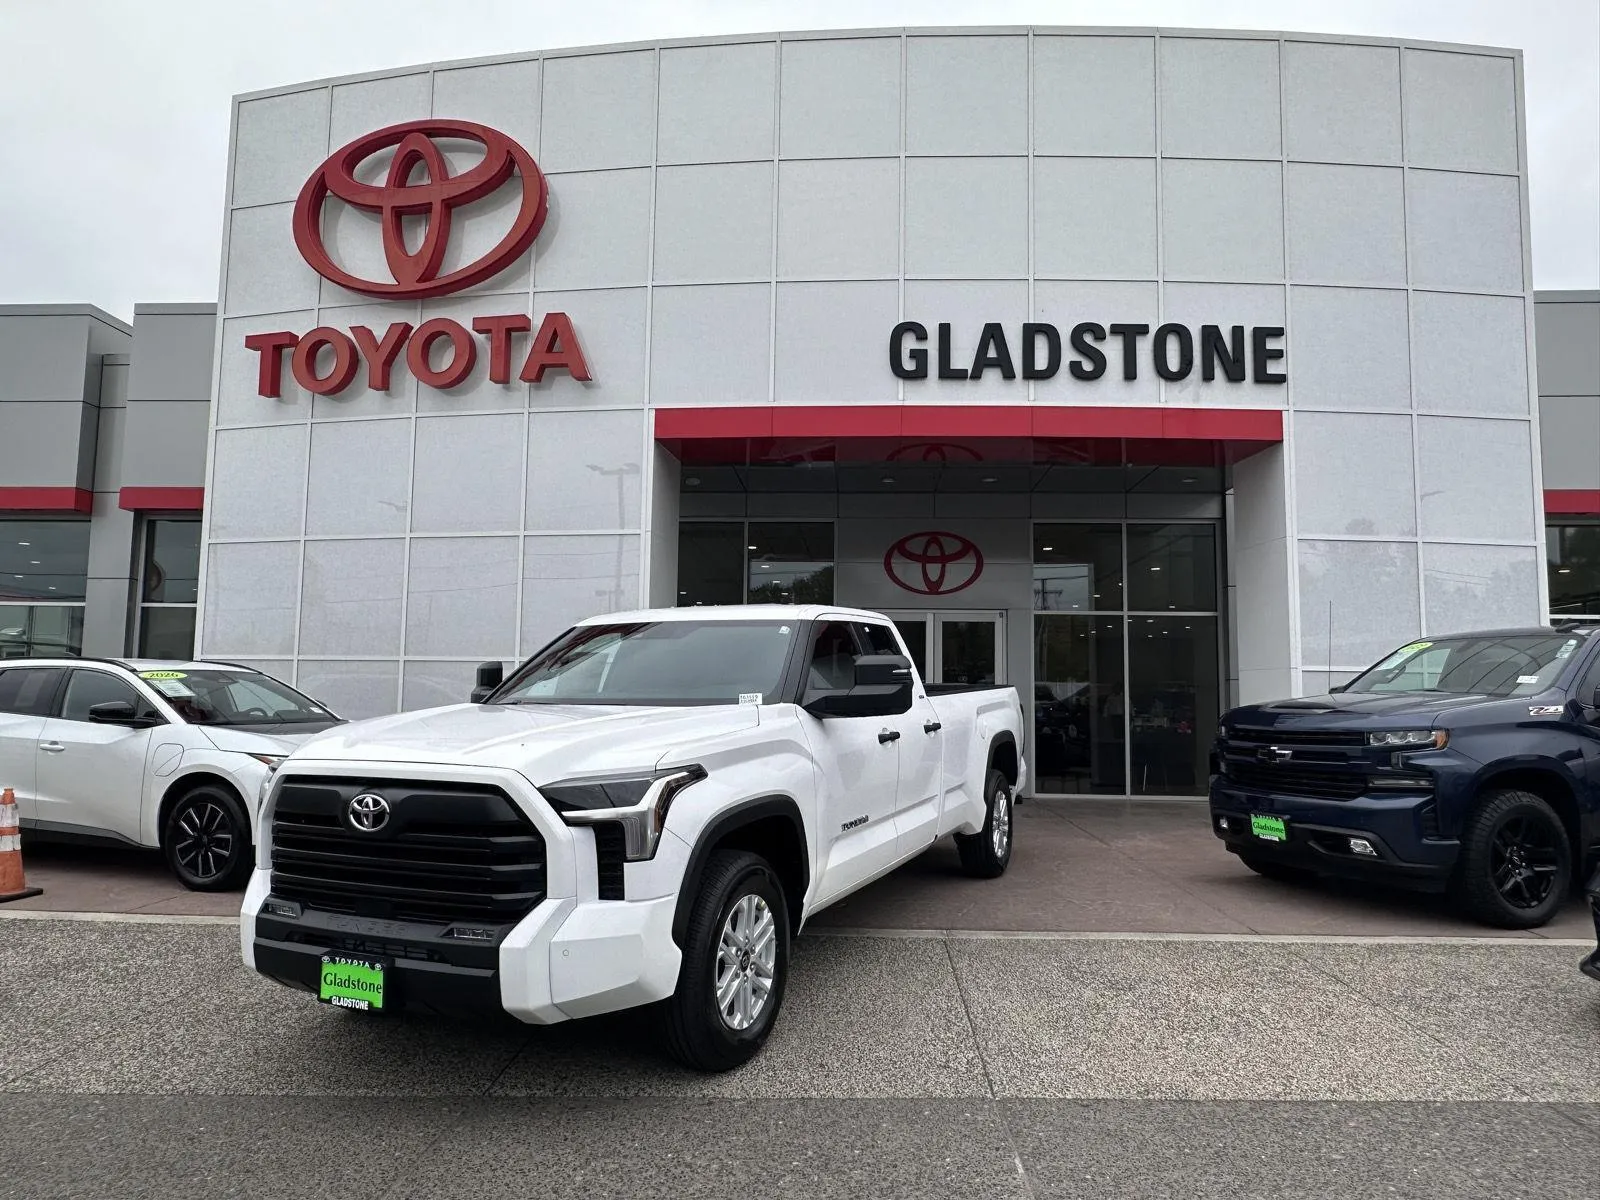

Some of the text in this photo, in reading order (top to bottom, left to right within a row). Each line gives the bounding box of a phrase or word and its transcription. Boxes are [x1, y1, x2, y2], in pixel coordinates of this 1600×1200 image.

[245, 312, 592, 398] TOYOTA
[889, 321, 1287, 384] GLADSTONE
[335, 956, 370, 968] TOYOTA
[323, 972, 382, 994] Gladstone
[331, 995, 369, 1011] GLADSTONE
